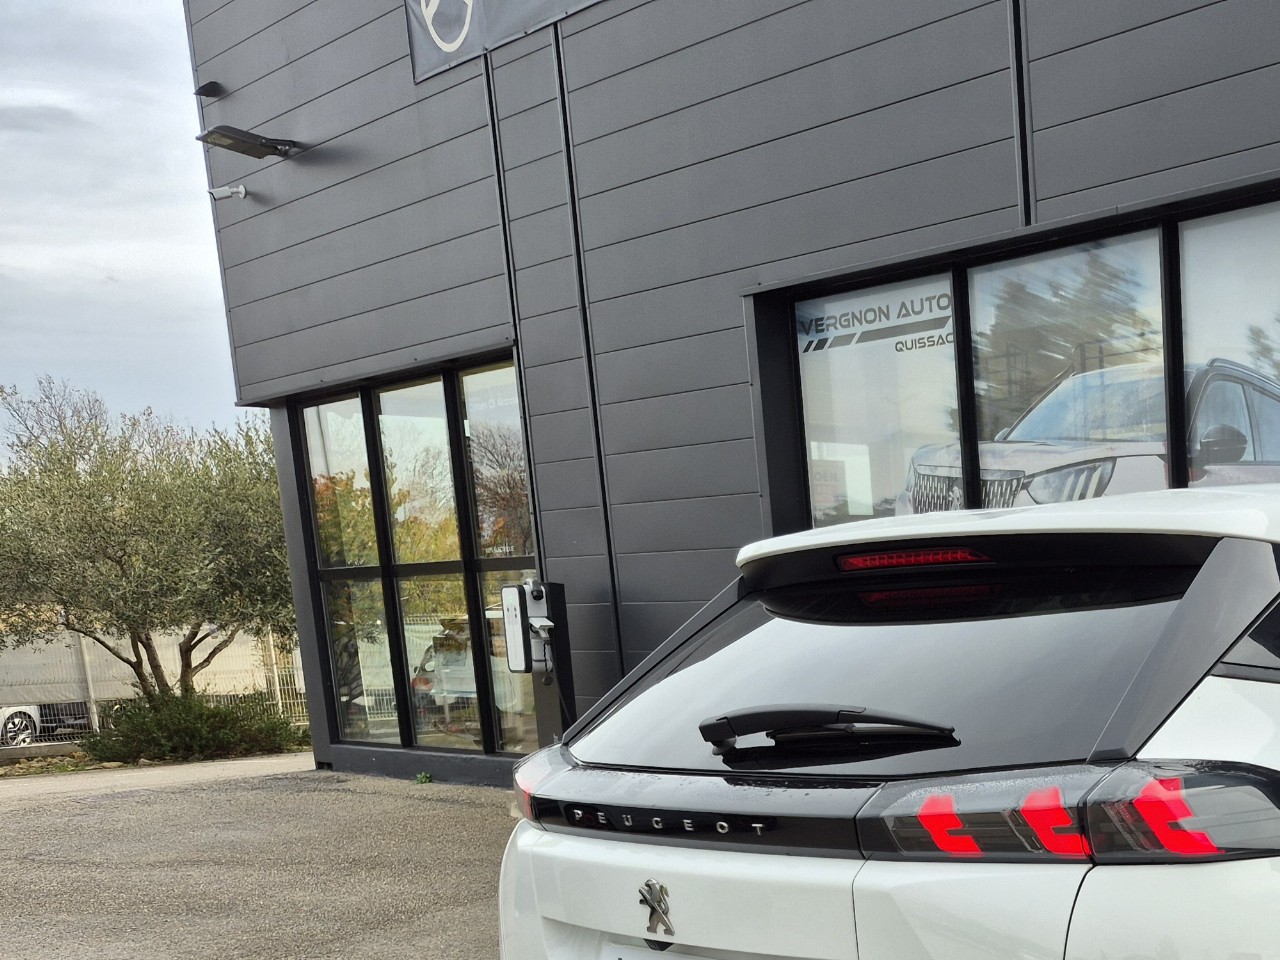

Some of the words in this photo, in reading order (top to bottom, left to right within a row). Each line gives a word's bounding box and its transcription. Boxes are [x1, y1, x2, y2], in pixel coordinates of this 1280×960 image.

[800, 305, 891, 337] VERGNON
[896, 293, 952, 319] AUTO
[894, 332, 954, 353] QUISSAC
[573, 809, 766, 837] PEUGEOT
